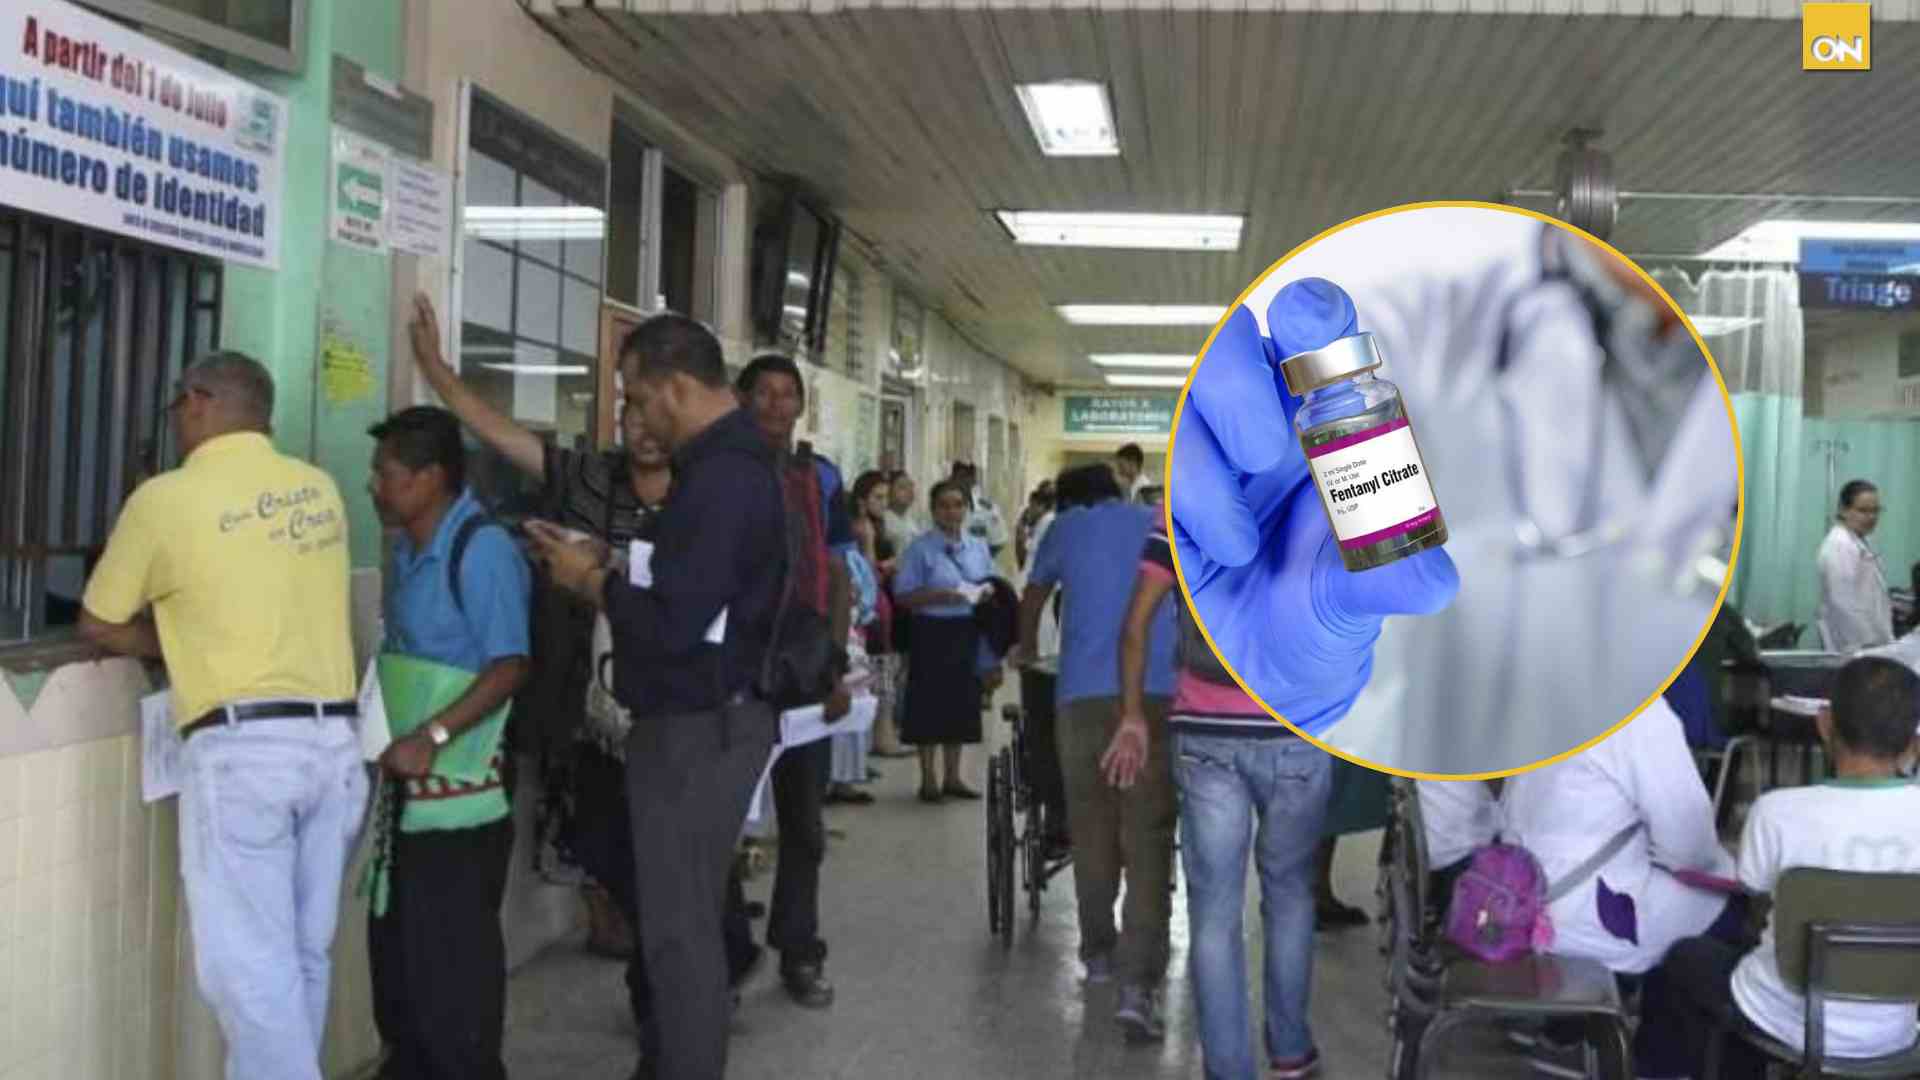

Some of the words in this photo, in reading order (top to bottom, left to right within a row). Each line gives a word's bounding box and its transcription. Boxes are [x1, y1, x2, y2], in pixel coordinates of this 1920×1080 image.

[23, 16, 39, 57] A
[43, 29, 107, 82] partir
[110, 53, 143, 96] del
[160, 74, 183, 112] de
[47, 87, 163, 162] también
[168, 134, 260, 192] usamos
[115, 161, 148, 206] de
[1822, 277, 1912, 307] Triage
[1329, 475, 1381, 503] Fentanyl
[1381, 463, 1420, 487] Citrate
